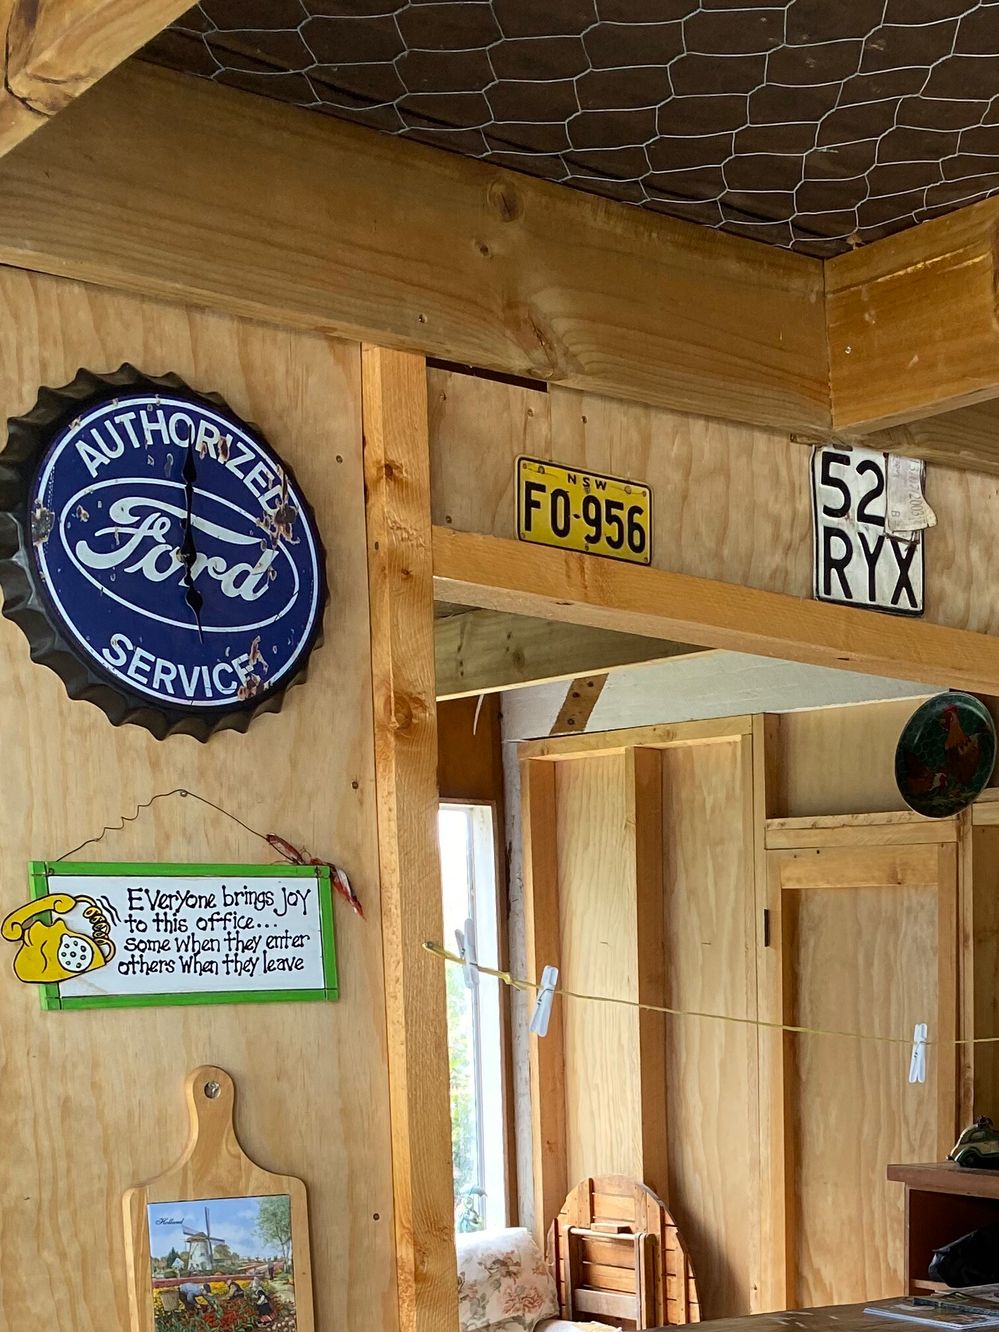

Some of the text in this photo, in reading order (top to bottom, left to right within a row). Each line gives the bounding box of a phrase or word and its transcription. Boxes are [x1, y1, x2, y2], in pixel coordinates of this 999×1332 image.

[75, 409, 290, 516] AUTHORIZED
[821, 451, 885, 527] 52
[76, 497, 278, 601] Ford
[823, 526, 918, 608] RYX
[102, 633, 254, 697] SERVICE
[124, 913, 148, 934] to
[152, 912, 189, 933] this
[220, 885, 275, 909] brings
[117, 951, 305, 977] others when they leave
[123, 929, 311, 959] some when they enter
